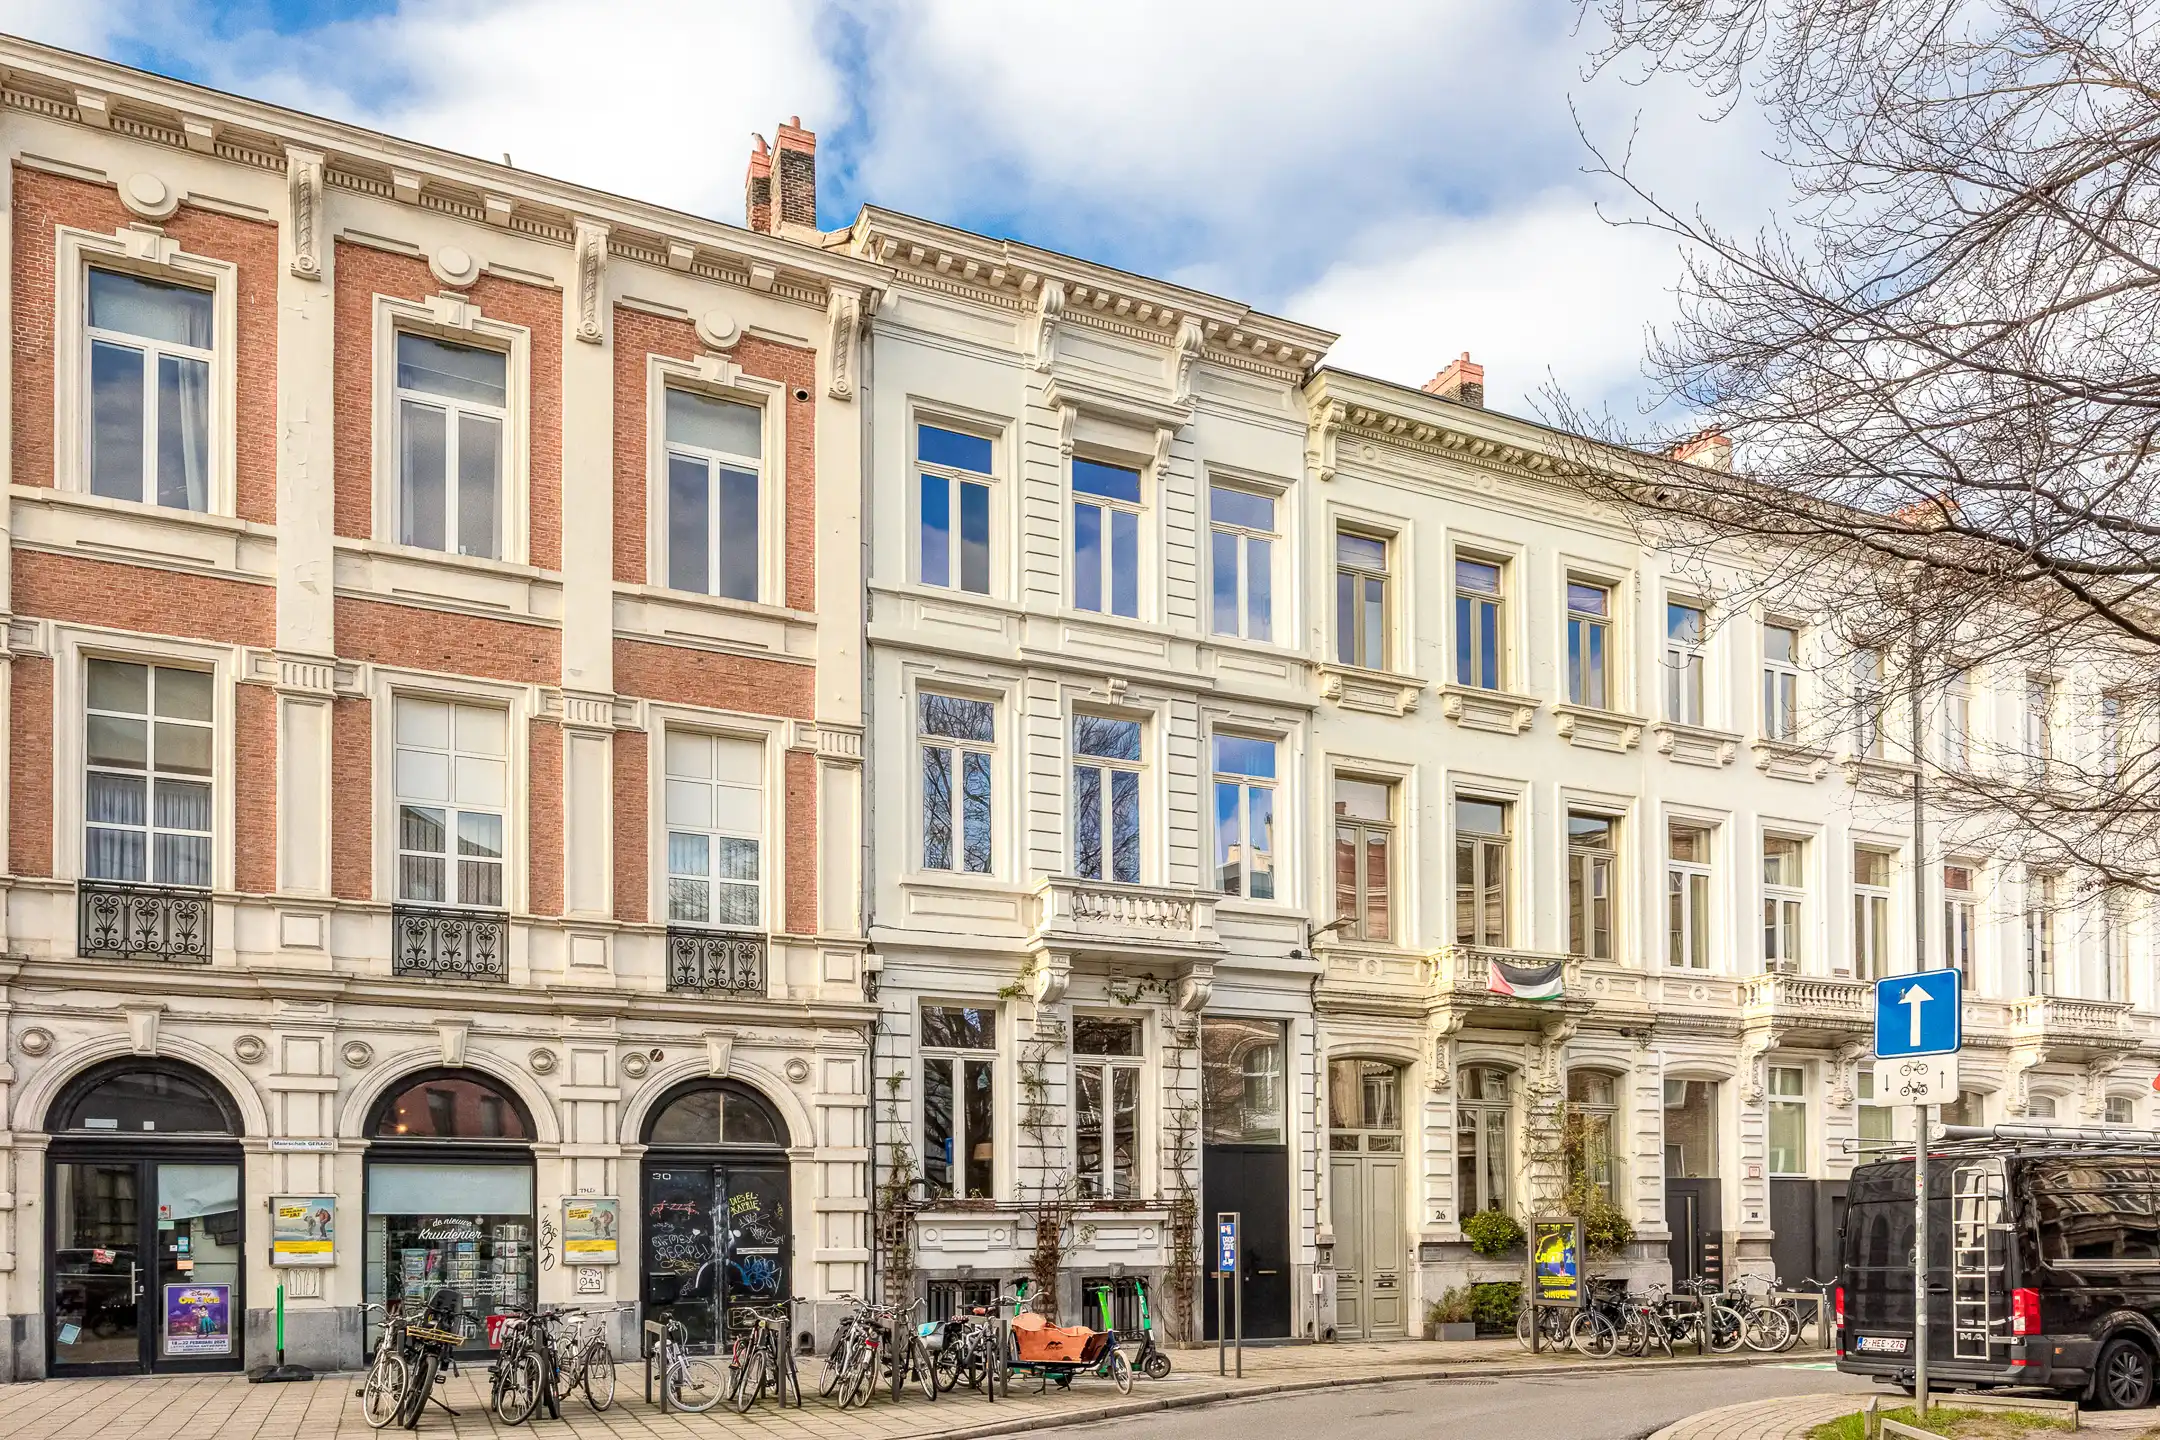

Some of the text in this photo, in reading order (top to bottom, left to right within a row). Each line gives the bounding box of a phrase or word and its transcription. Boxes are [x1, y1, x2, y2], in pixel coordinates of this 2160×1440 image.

[652, 1172, 672, 1181] 30
[1435, 1210, 1446, 1220] 26
[432, 1217, 443, 1228] de
[418, 1227, 483, 1240] Kruidenier
